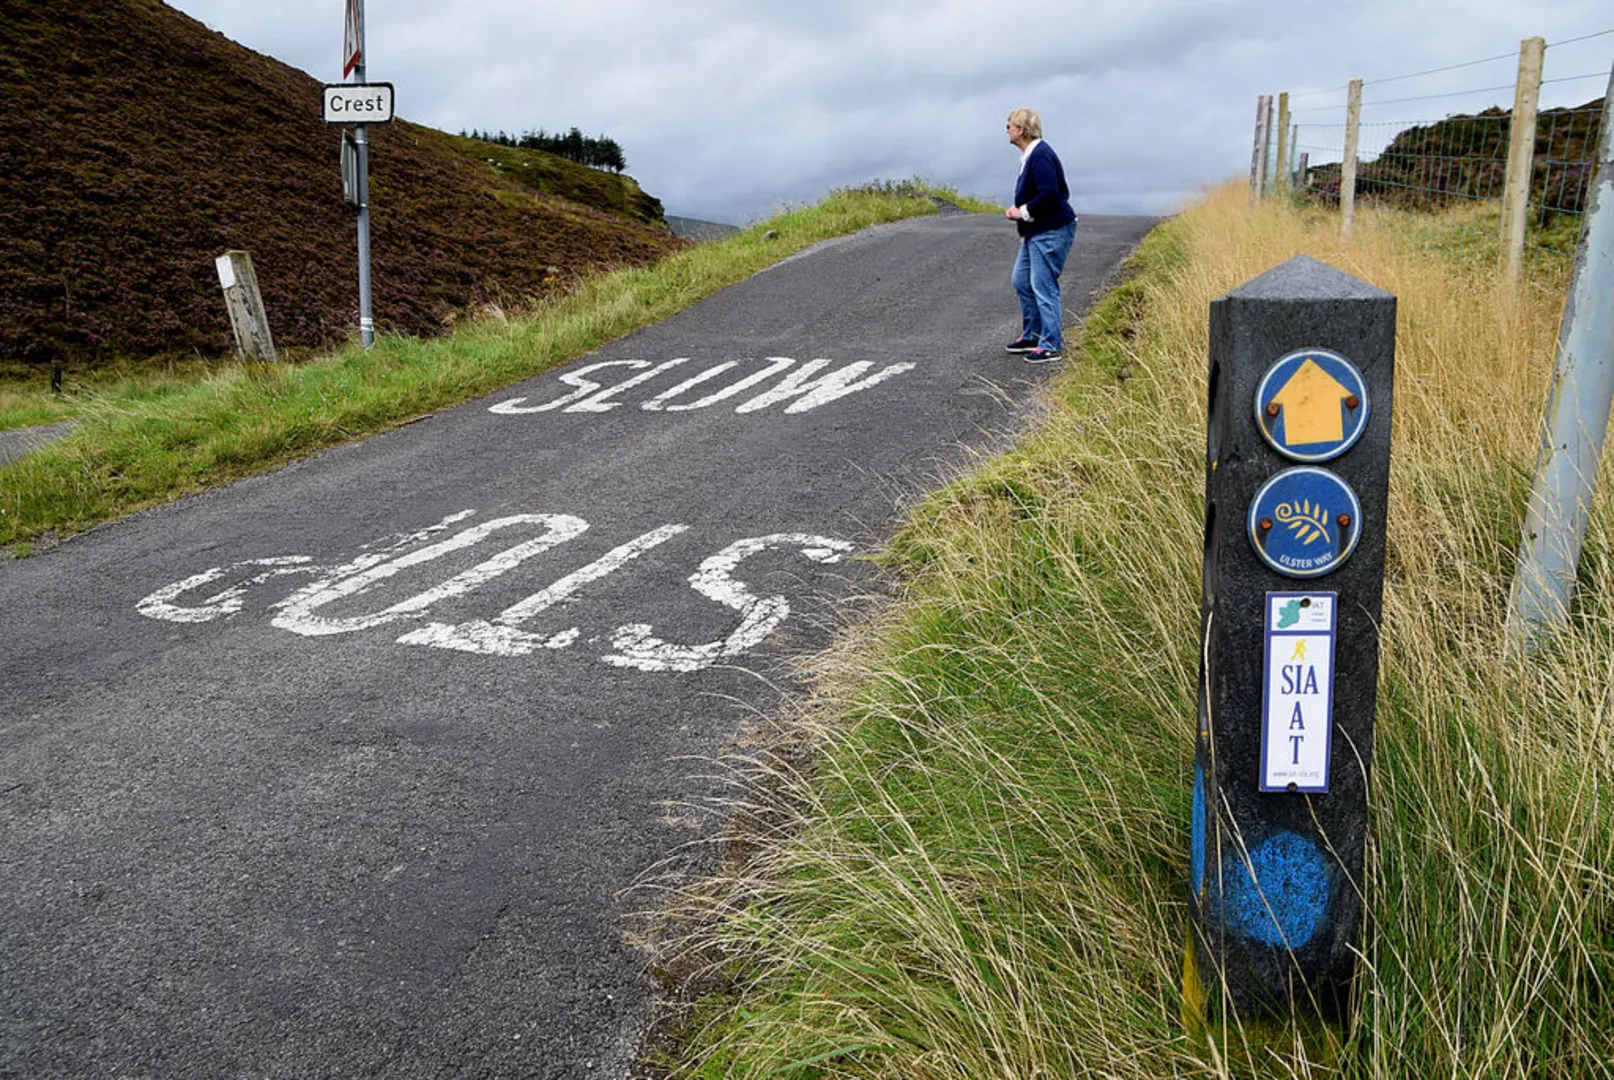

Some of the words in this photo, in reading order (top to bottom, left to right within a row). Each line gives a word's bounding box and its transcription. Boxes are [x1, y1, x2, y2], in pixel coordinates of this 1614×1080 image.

[330, 95, 383, 112] Crest
[488, 356, 916, 415] SLOW
[1279, 554, 1313, 569] ULSTER
[1312, 551, 1333, 566] WAY
[1280, 664, 1320, 694] SIA
